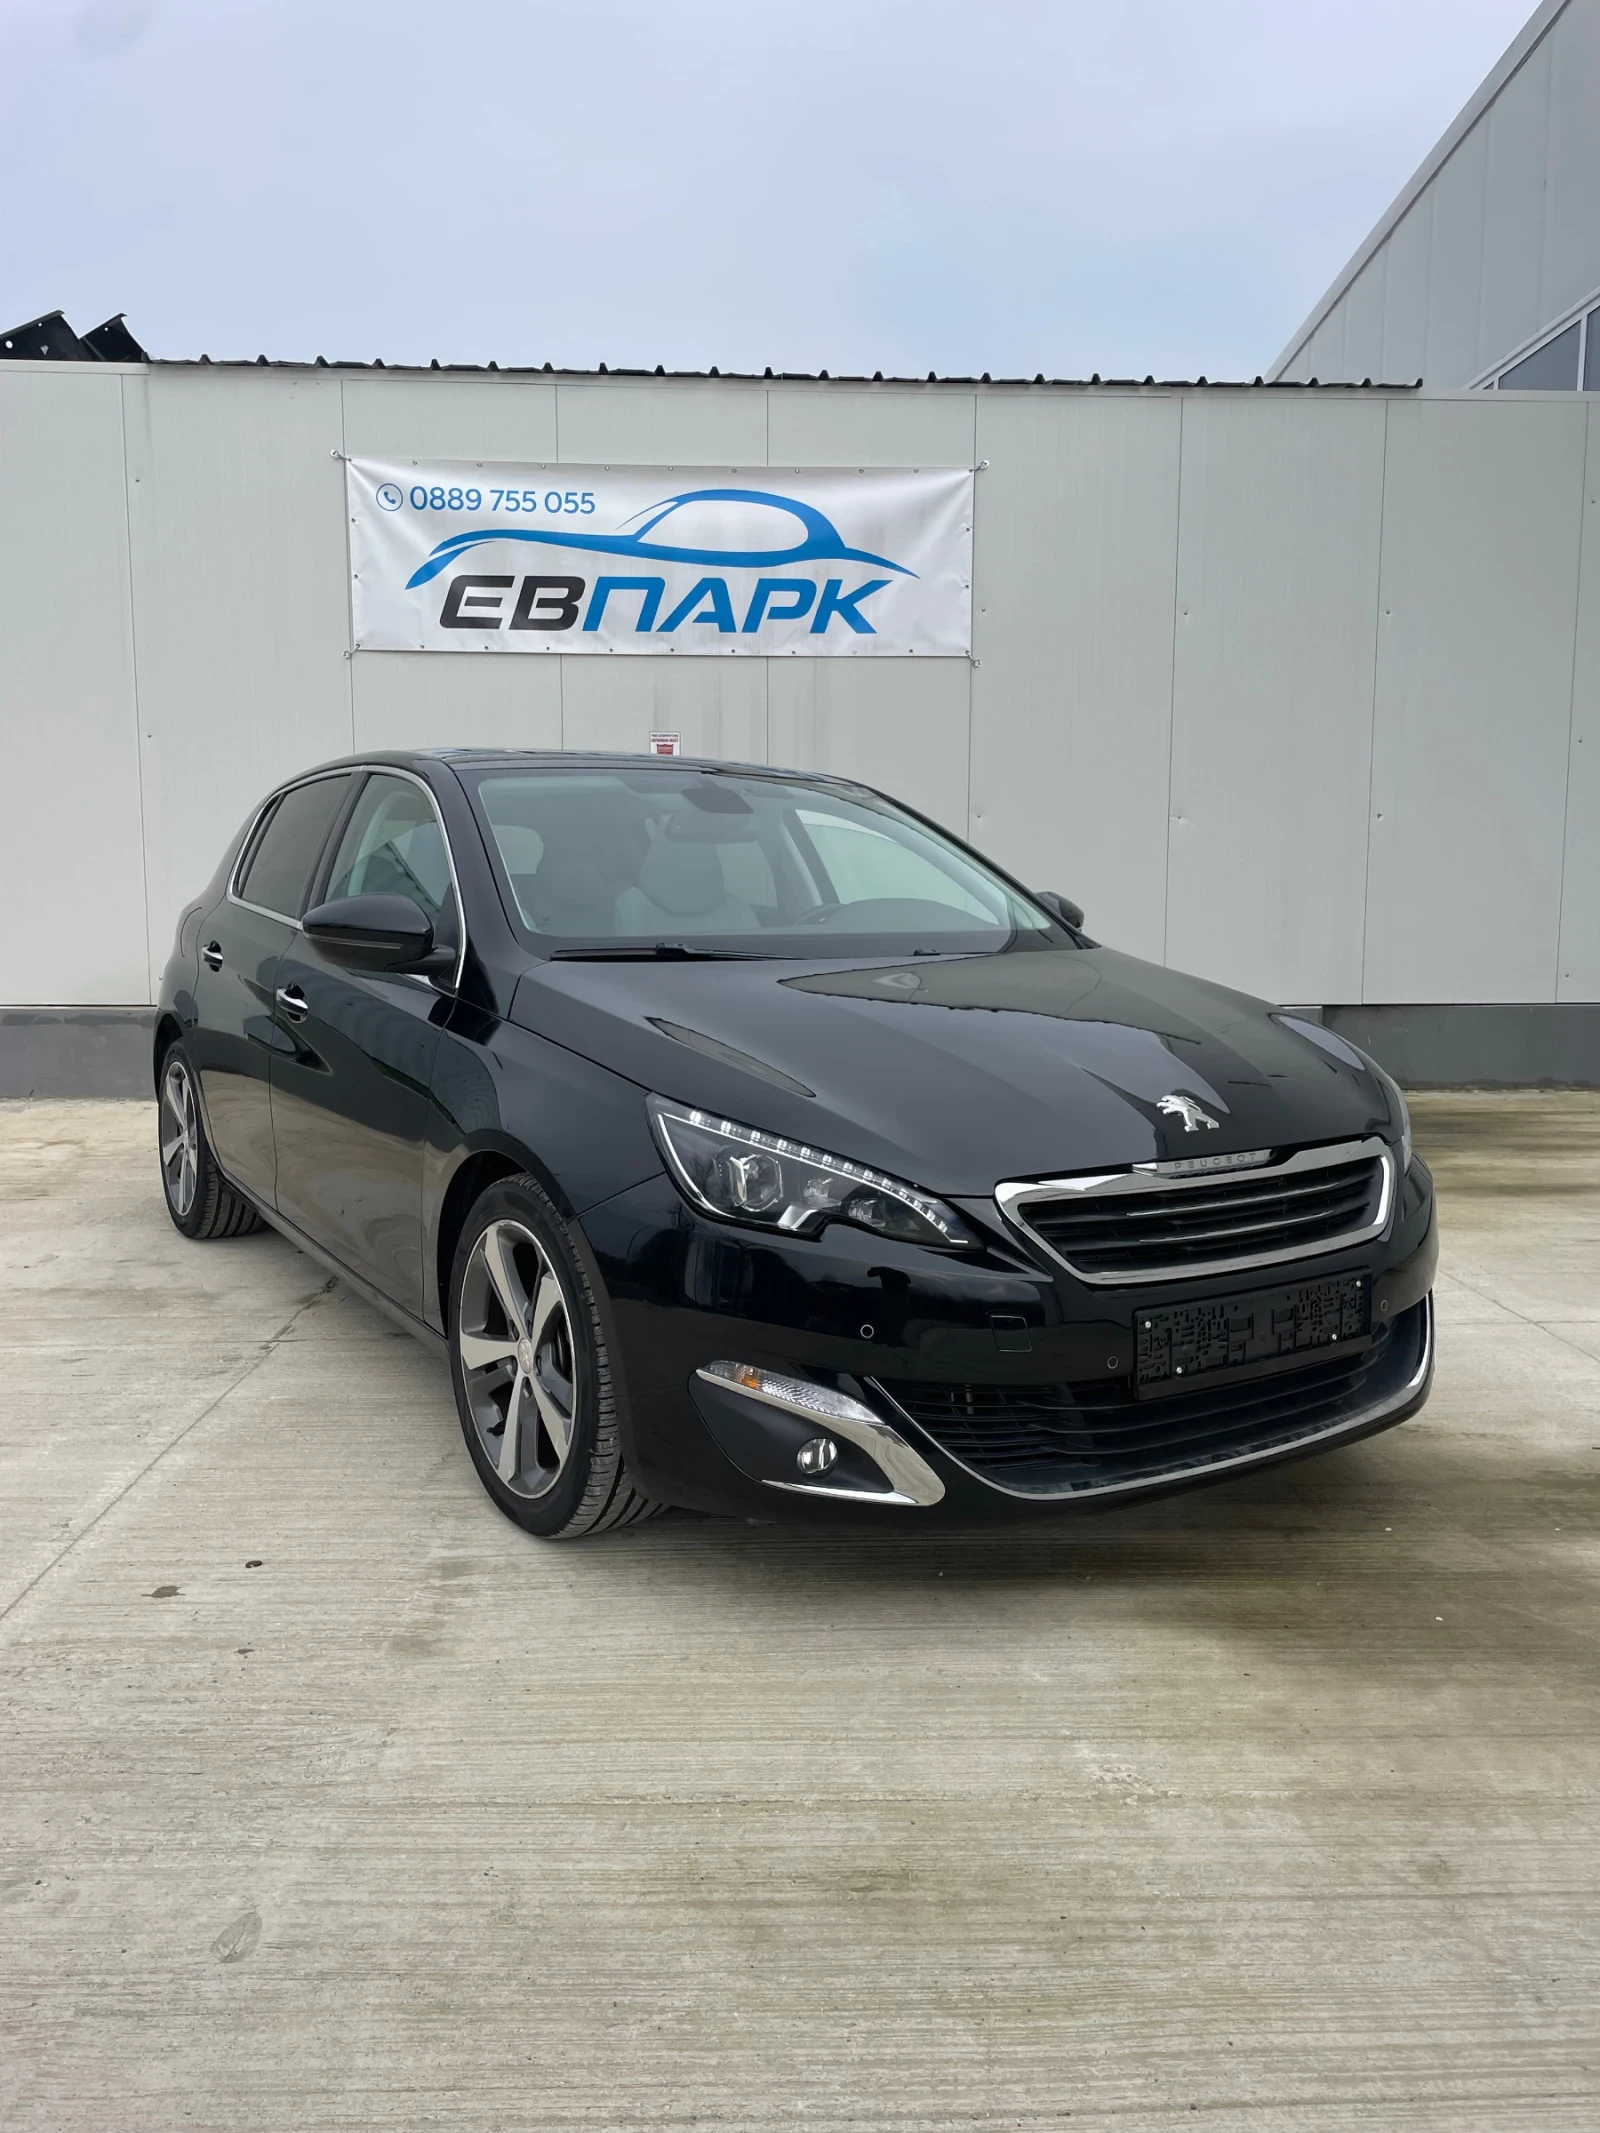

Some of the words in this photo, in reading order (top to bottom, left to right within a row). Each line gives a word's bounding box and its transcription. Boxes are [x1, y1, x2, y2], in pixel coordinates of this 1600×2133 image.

[409, 485, 482, 511] 0889
[489, 489, 537, 512] 755
[544, 491, 596, 515] 055
[439, 575, 894, 634] ЕВПАРК
[1174, 1152, 1257, 1171] PEUGEOT
